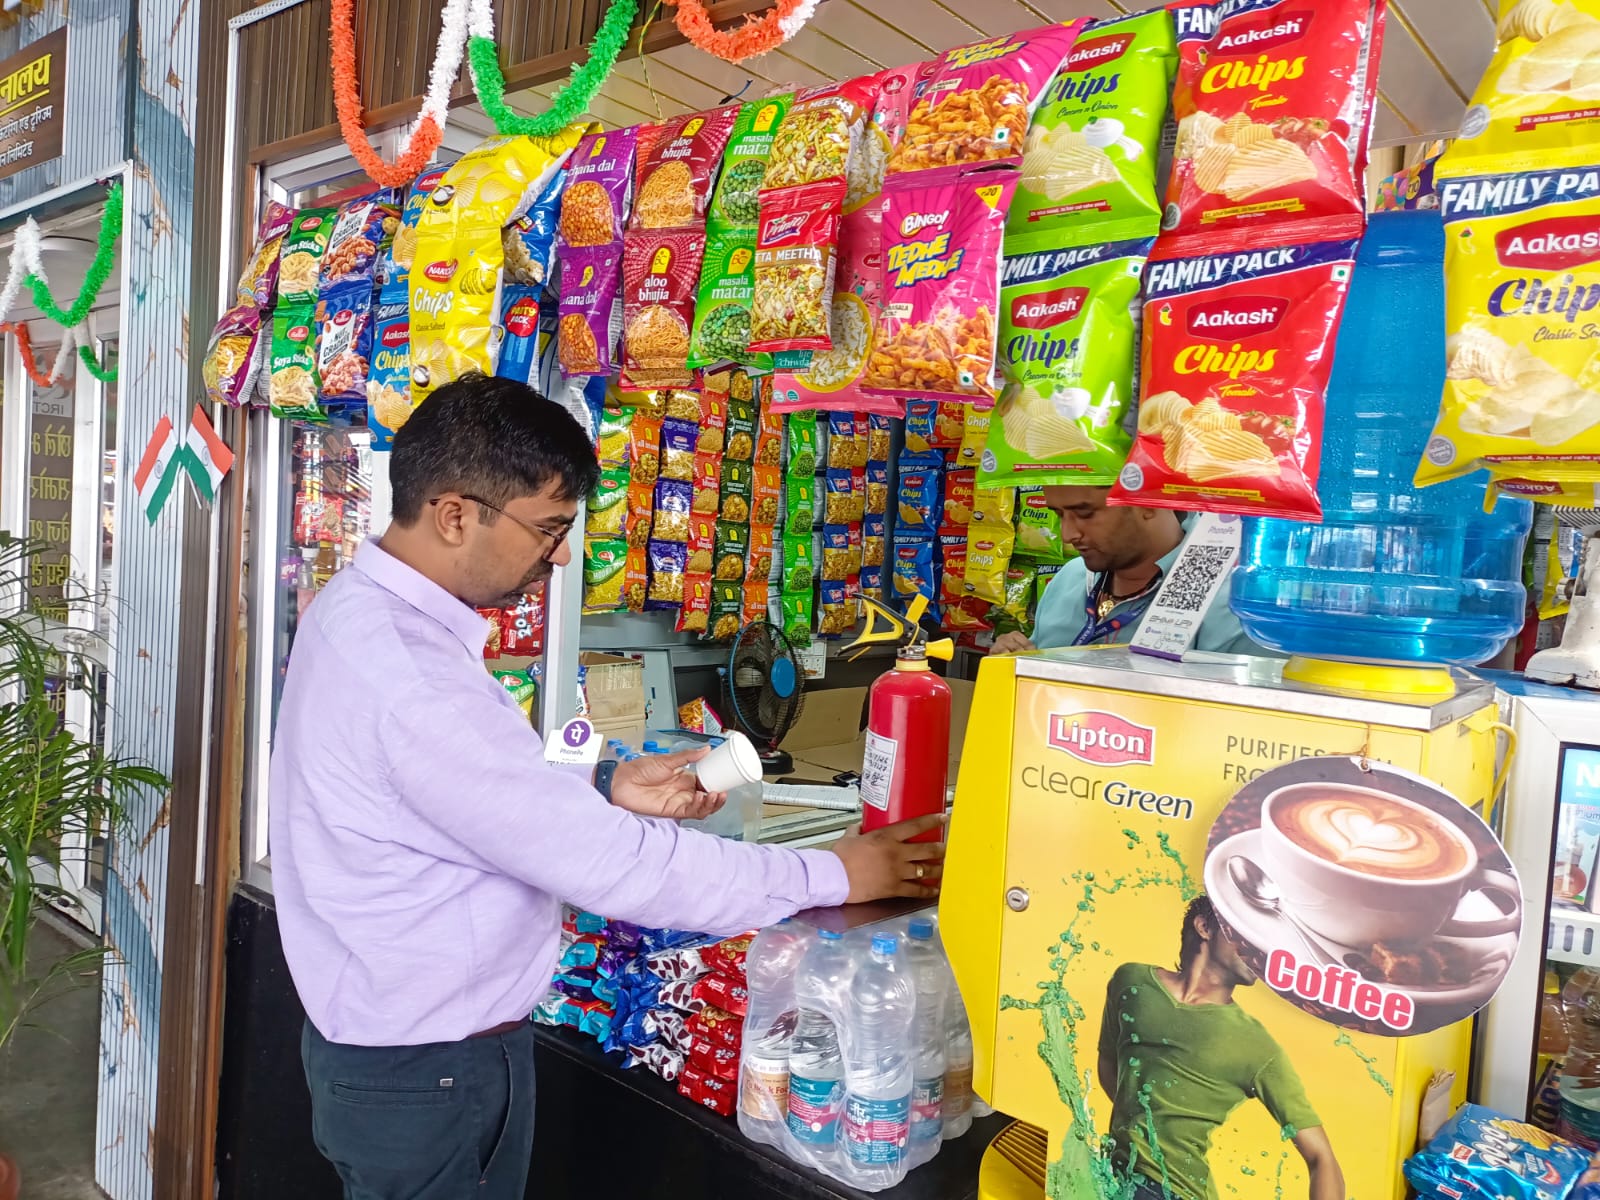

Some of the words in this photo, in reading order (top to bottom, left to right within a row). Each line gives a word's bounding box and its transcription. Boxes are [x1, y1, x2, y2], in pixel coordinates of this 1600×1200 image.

[1217, 20, 1299, 49] Aakash
[1200, 55, 1305, 95] Chips
[671, 137, 693, 148] aloo
[733, 142, 769, 155] mata
[742, 134, 773, 143] masala
[661, 145, 692, 158] bhujia
[597, 159, 616, 172] dal
[1441, 177, 1552, 217] FAMILY
[888, 232, 952, 272] TEDHE
[1505, 232, 1600, 256] Aakas
[894, 248, 965, 287] MEDHE
[1054, 246, 1103, 272] PACK
[1147, 256, 1231, 292] FAMILY
[1227, 247, 1296, 276] PACK
[638, 287, 669, 301] bhujia
[644, 277, 668, 288] aloo
[711, 287, 754, 299] matar
[718, 277, 749, 287] masala
[413, 287, 454, 320] Chips
[1015, 296, 1080, 319] Aakash
[1487, 274, 1600, 323] Chip
[1192, 309, 1276, 328] Aakash
[1007, 331, 1080, 367] Chips
[1173, 344, 1280, 379] Chips
[273, 357, 291, 368] Soya
[1022, 508, 1048, 520] Chips
[1055, 717, 1146, 754] Lipton
[1021, 765, 1103, 801] clear
[1103, 781, 1194, 820] Green
[1265, 949, 1415, 1031] Coffee
